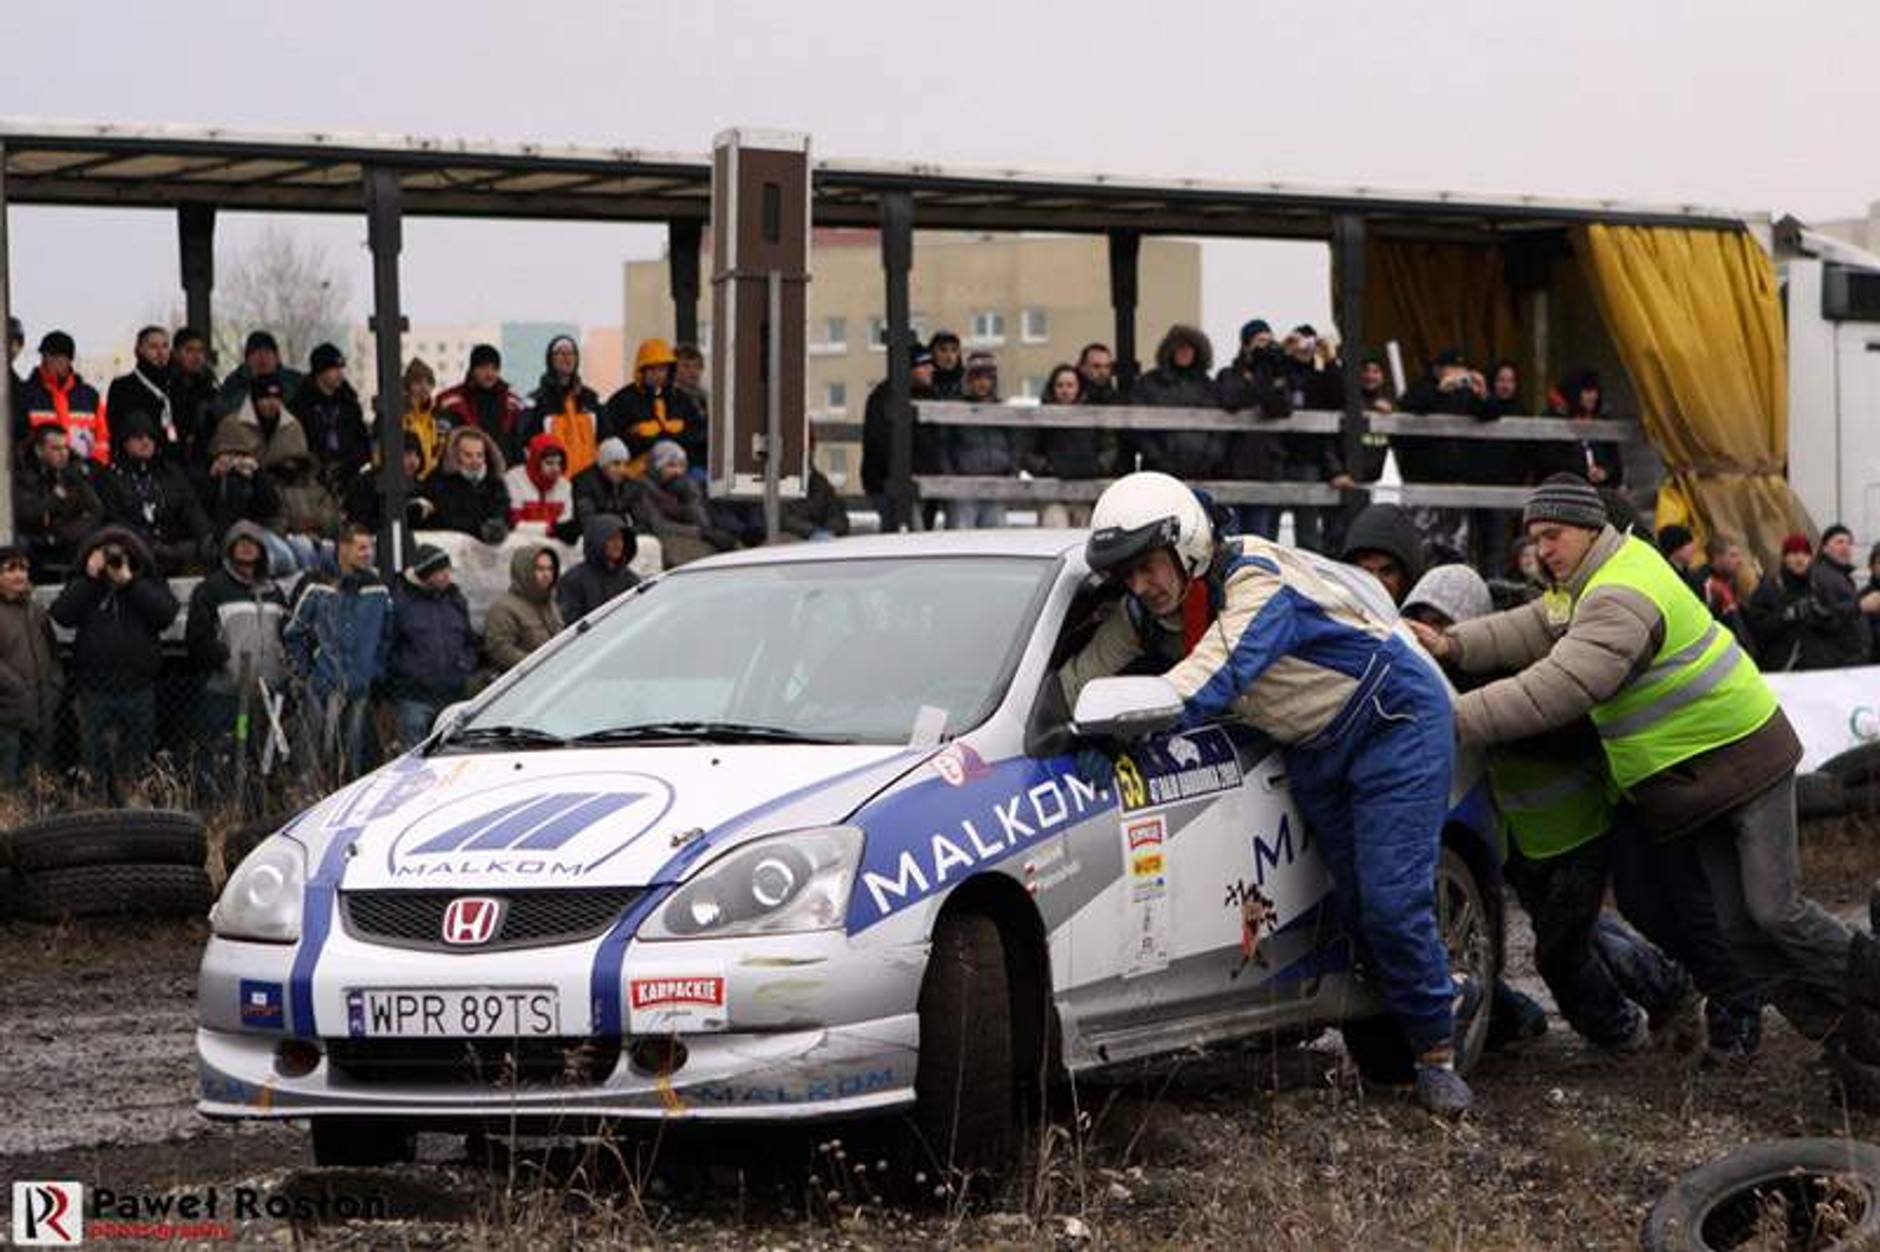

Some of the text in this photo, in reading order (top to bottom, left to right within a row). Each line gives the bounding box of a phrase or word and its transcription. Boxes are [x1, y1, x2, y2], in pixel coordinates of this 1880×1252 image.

[1253, 813, 1309, 886] M
[398, 860, 585, 877] MALKOM
[638, 980, 716, 1004] KARPACKIE
[370, 995, 551, 1034] WPR 89TS
